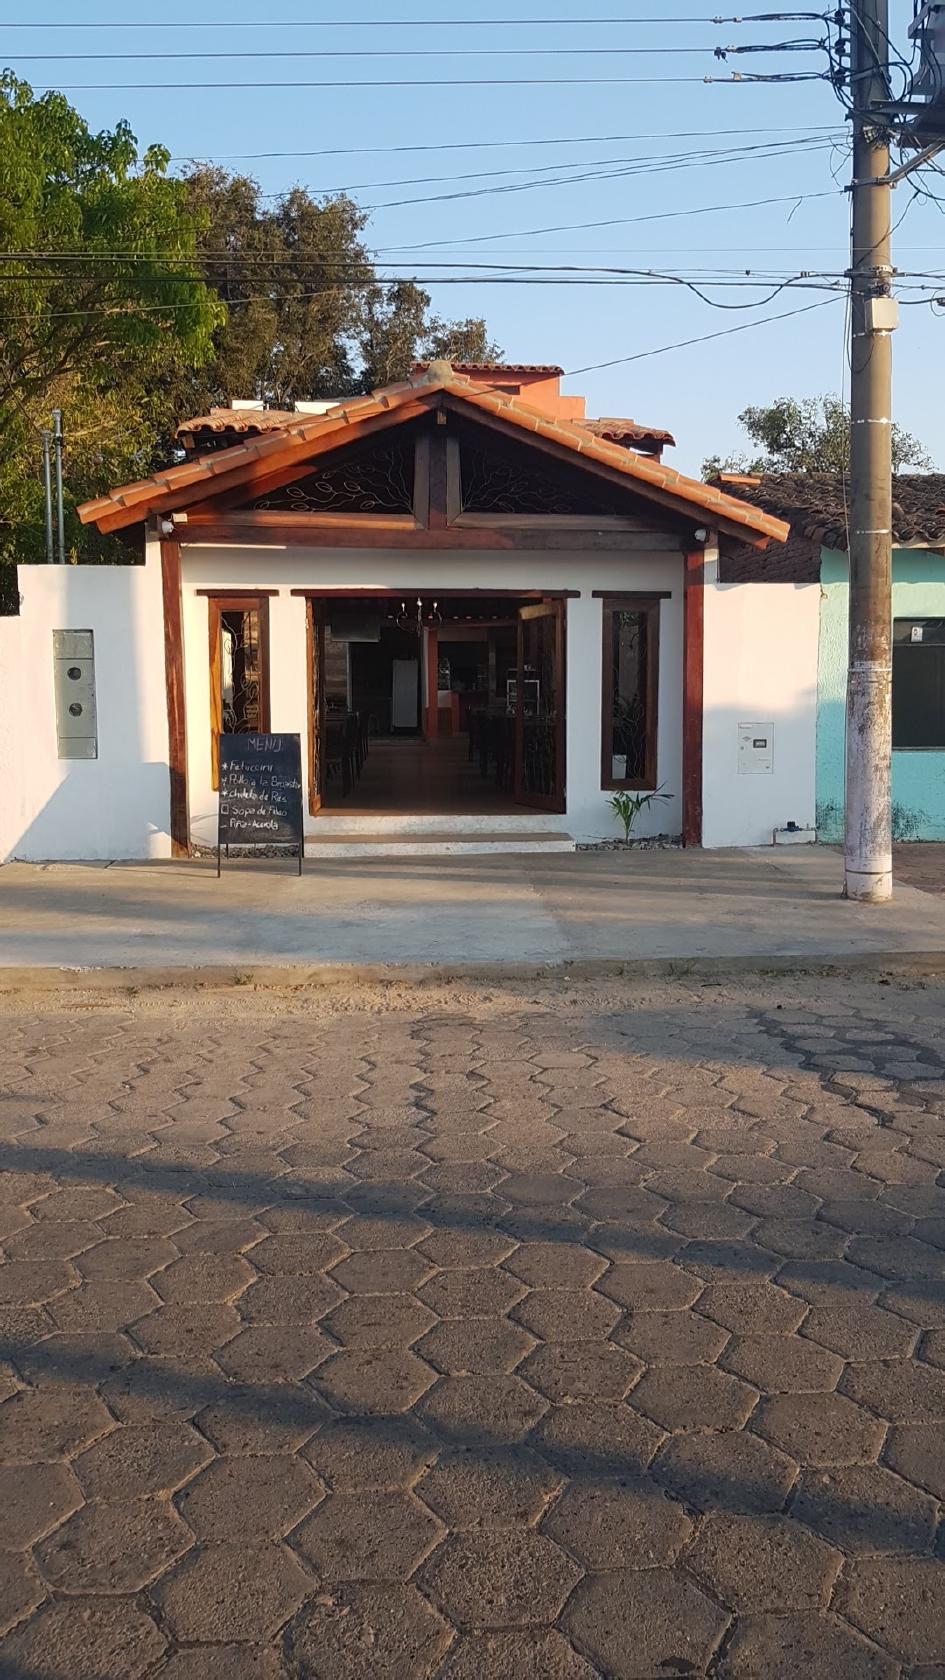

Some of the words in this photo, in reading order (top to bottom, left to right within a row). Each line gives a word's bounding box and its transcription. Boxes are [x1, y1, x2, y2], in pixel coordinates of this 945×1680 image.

[247, 737, 282, 752] MENU
[229, 774, 248, 786] Pollo
[259, 790, 268, 801] de
[271, 791, 287, 803] Res
[231, 805, 255, 817] Sopa
[257, 805, 266, 816] de
